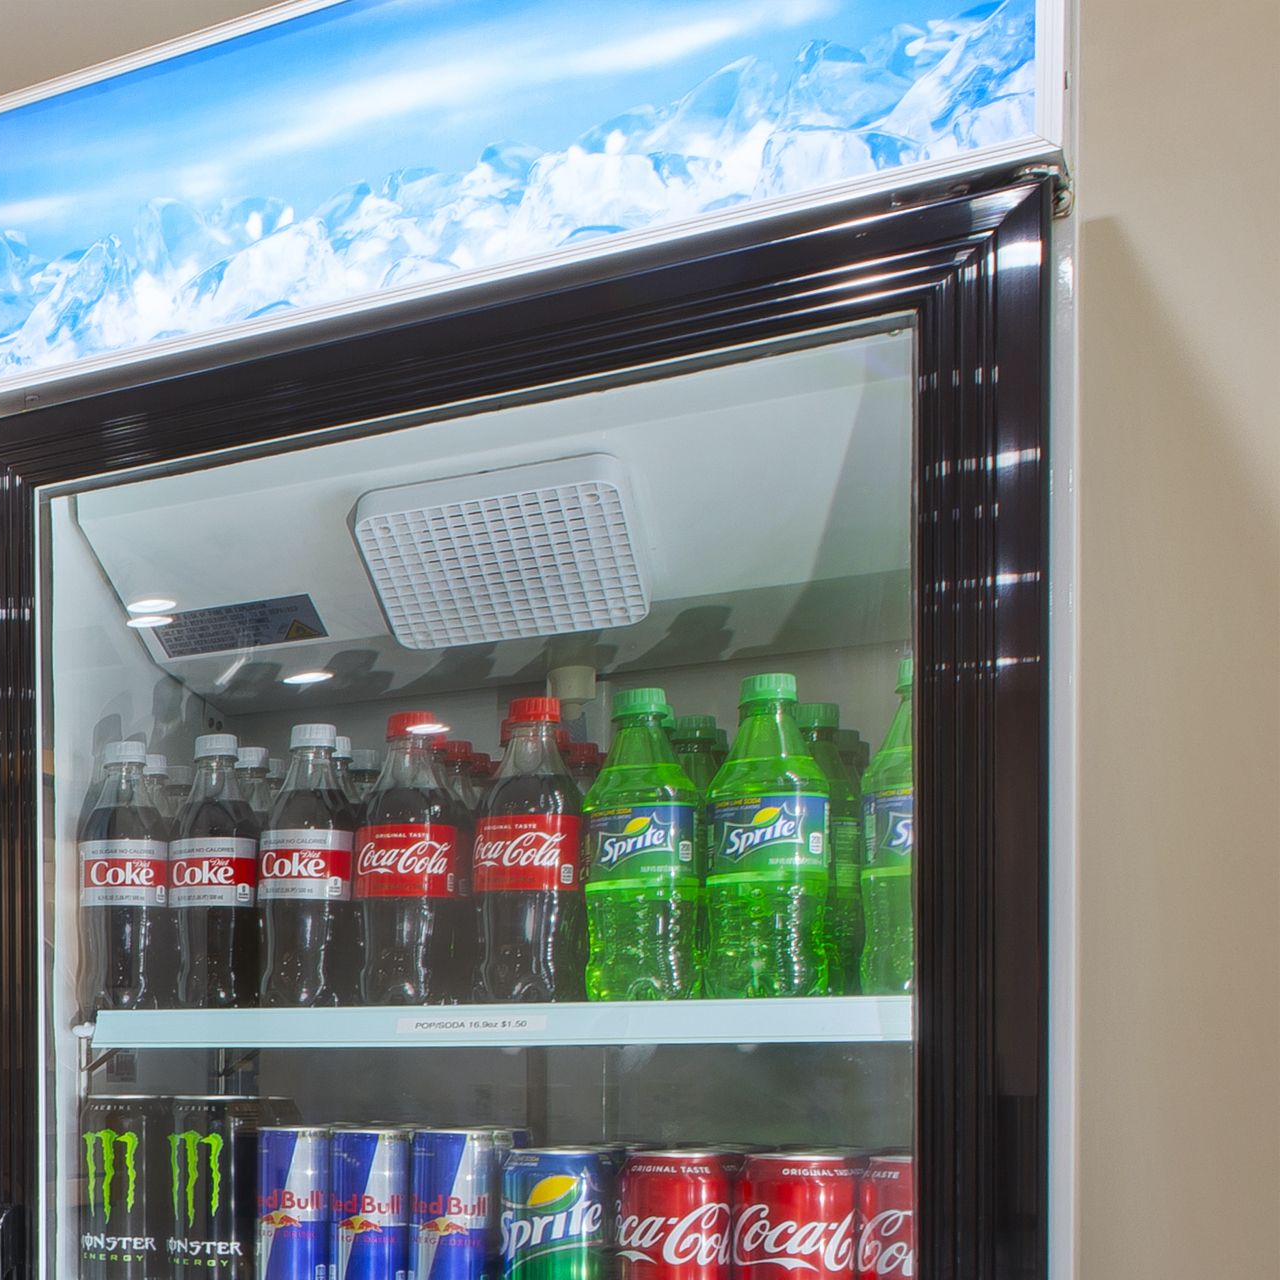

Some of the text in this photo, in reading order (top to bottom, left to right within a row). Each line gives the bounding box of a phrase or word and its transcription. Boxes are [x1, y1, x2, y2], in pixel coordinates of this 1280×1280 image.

[602, 827, 666, 863] Sprite
[728, 817, 796, 854] Sprite
[209, 857, 230, 867] Diet
[262, 851, 326, 878] Coke
[357, 840, 453, 876] Coca-Cola
[91, 861, 154, 885] Coke
[173, 860, 235, 885] Coke
[414, 1019, 527, 1030] POP/SODA 16.9oz $1.50
